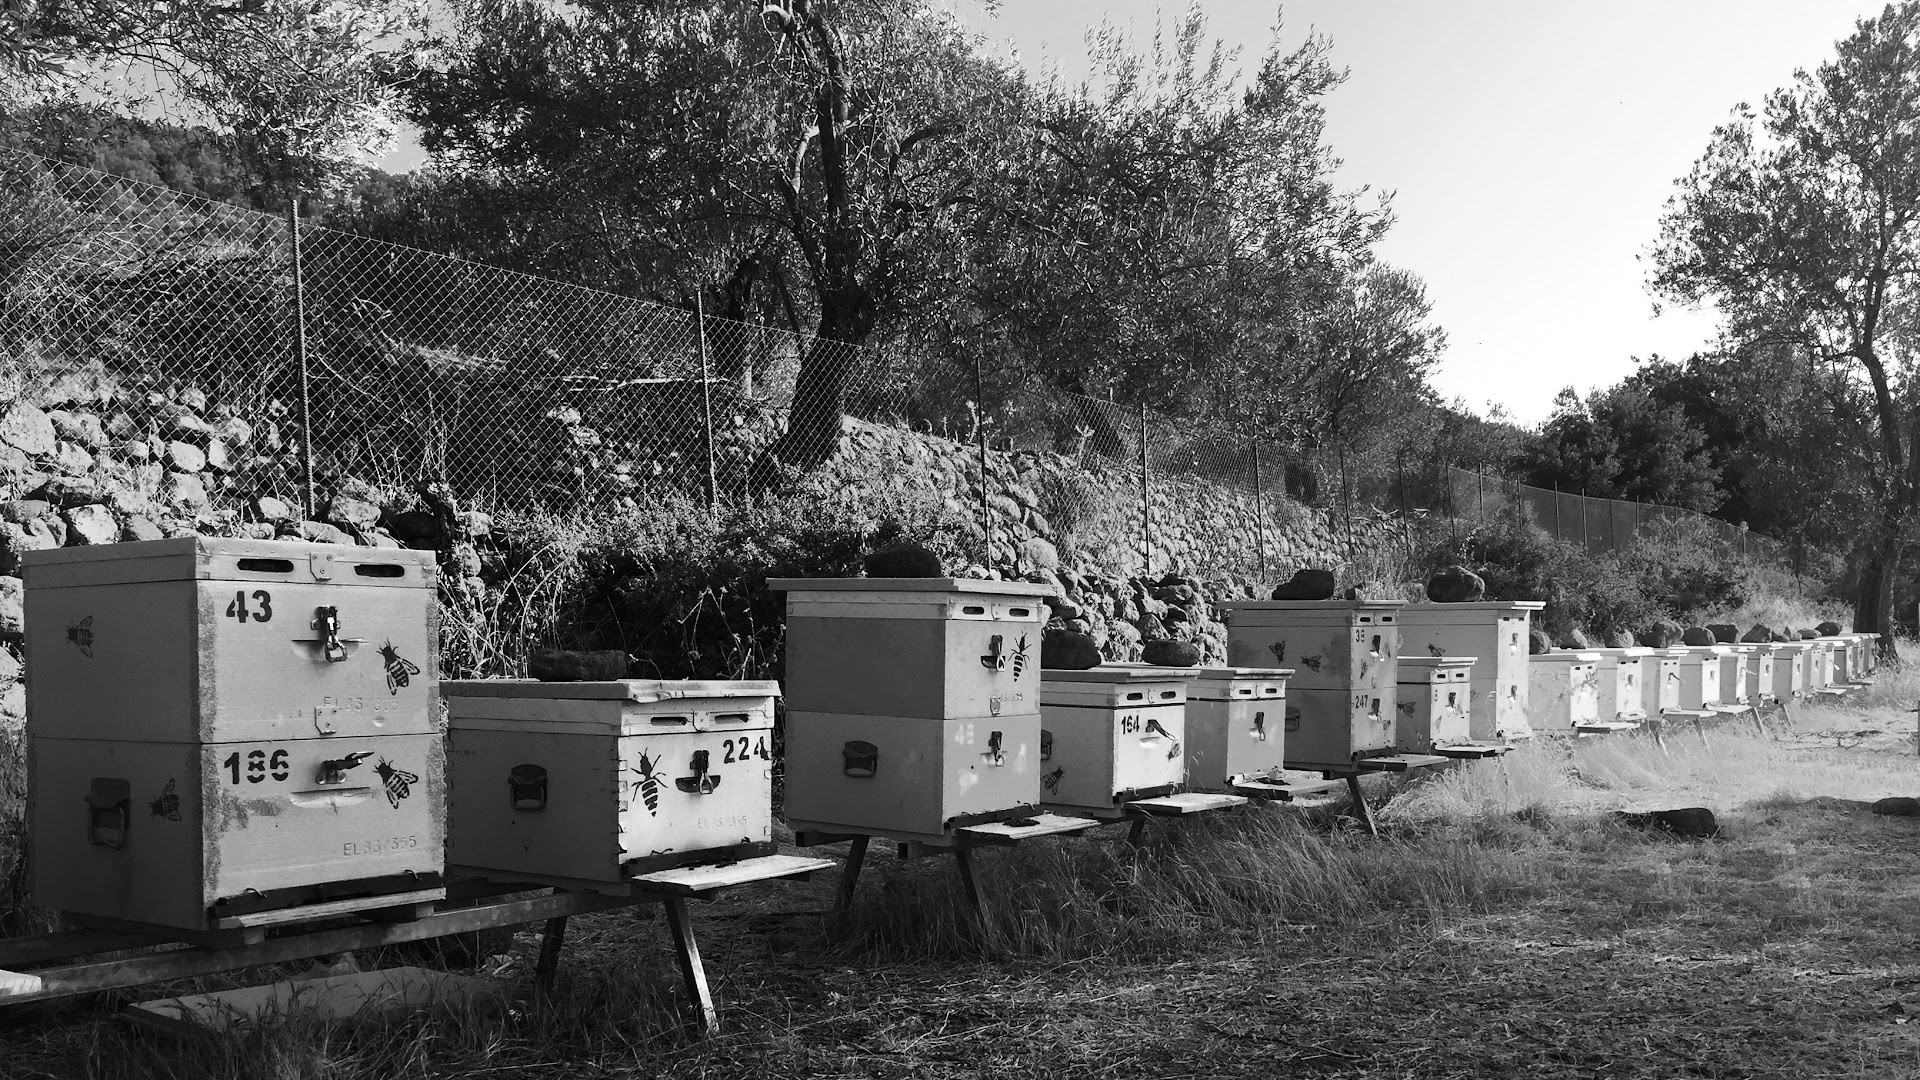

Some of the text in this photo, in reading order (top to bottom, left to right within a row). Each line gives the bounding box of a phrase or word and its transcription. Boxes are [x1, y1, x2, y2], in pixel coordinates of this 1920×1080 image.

[226, 589, 273, 624] 43
[1355, 694, 1369, 709] 247
[1121, 714, 1140, 735] 164
[722, 735, 770, 764] 224
[224, 749, 290, 785] 186
